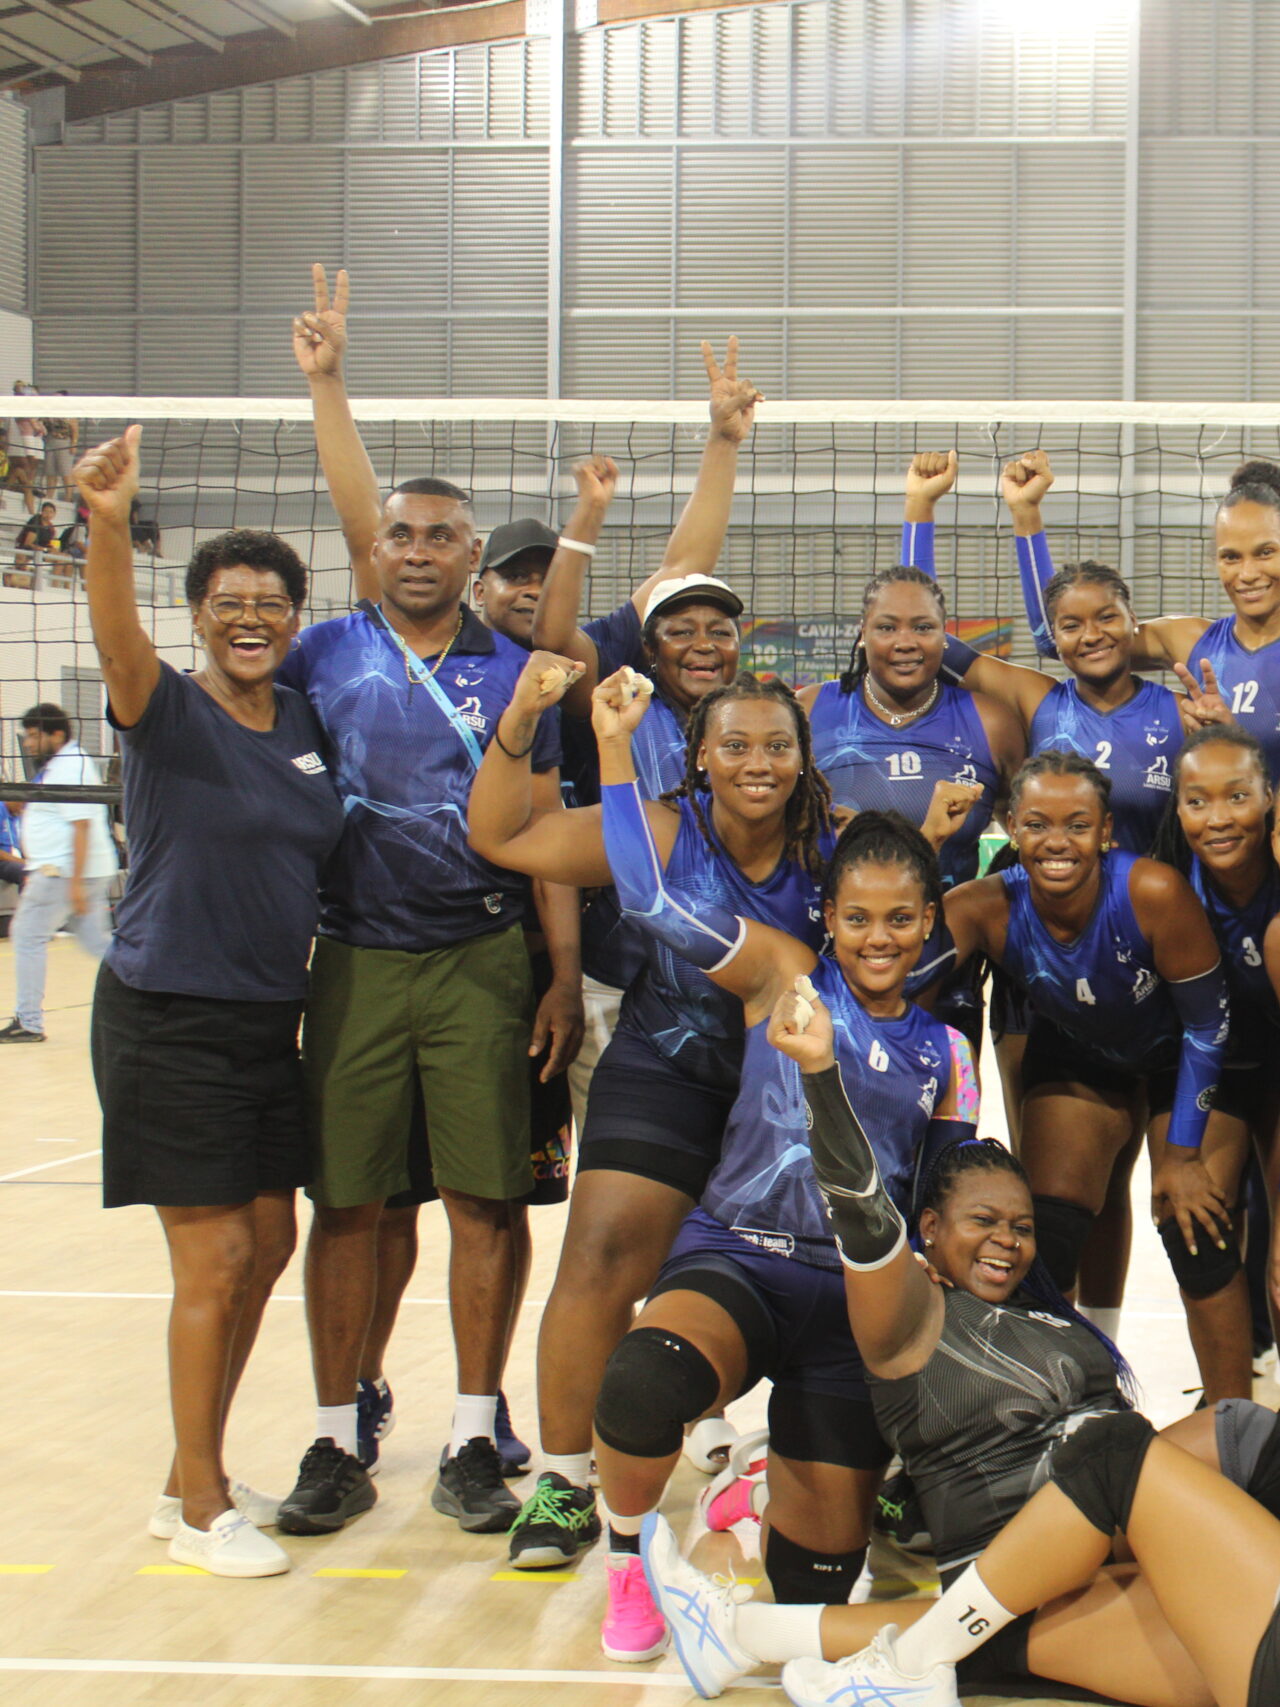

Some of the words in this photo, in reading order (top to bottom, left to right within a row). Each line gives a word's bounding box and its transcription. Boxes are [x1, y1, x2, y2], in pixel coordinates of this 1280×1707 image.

[1232, 680, 1258, 714] 12
[462, 714, 486, 729] RSU
[885, 751, 921, 776] 10
[1094, 741, 1112, 769] 2
[1147, 773, 1171, 788] ARSU
[1242, 937, 1262, 967] 3
[1076, 978, 1096, 1006] 4
[868, 1039, 889, 1072] 6
[958, 1604, 990, 1636] 16
